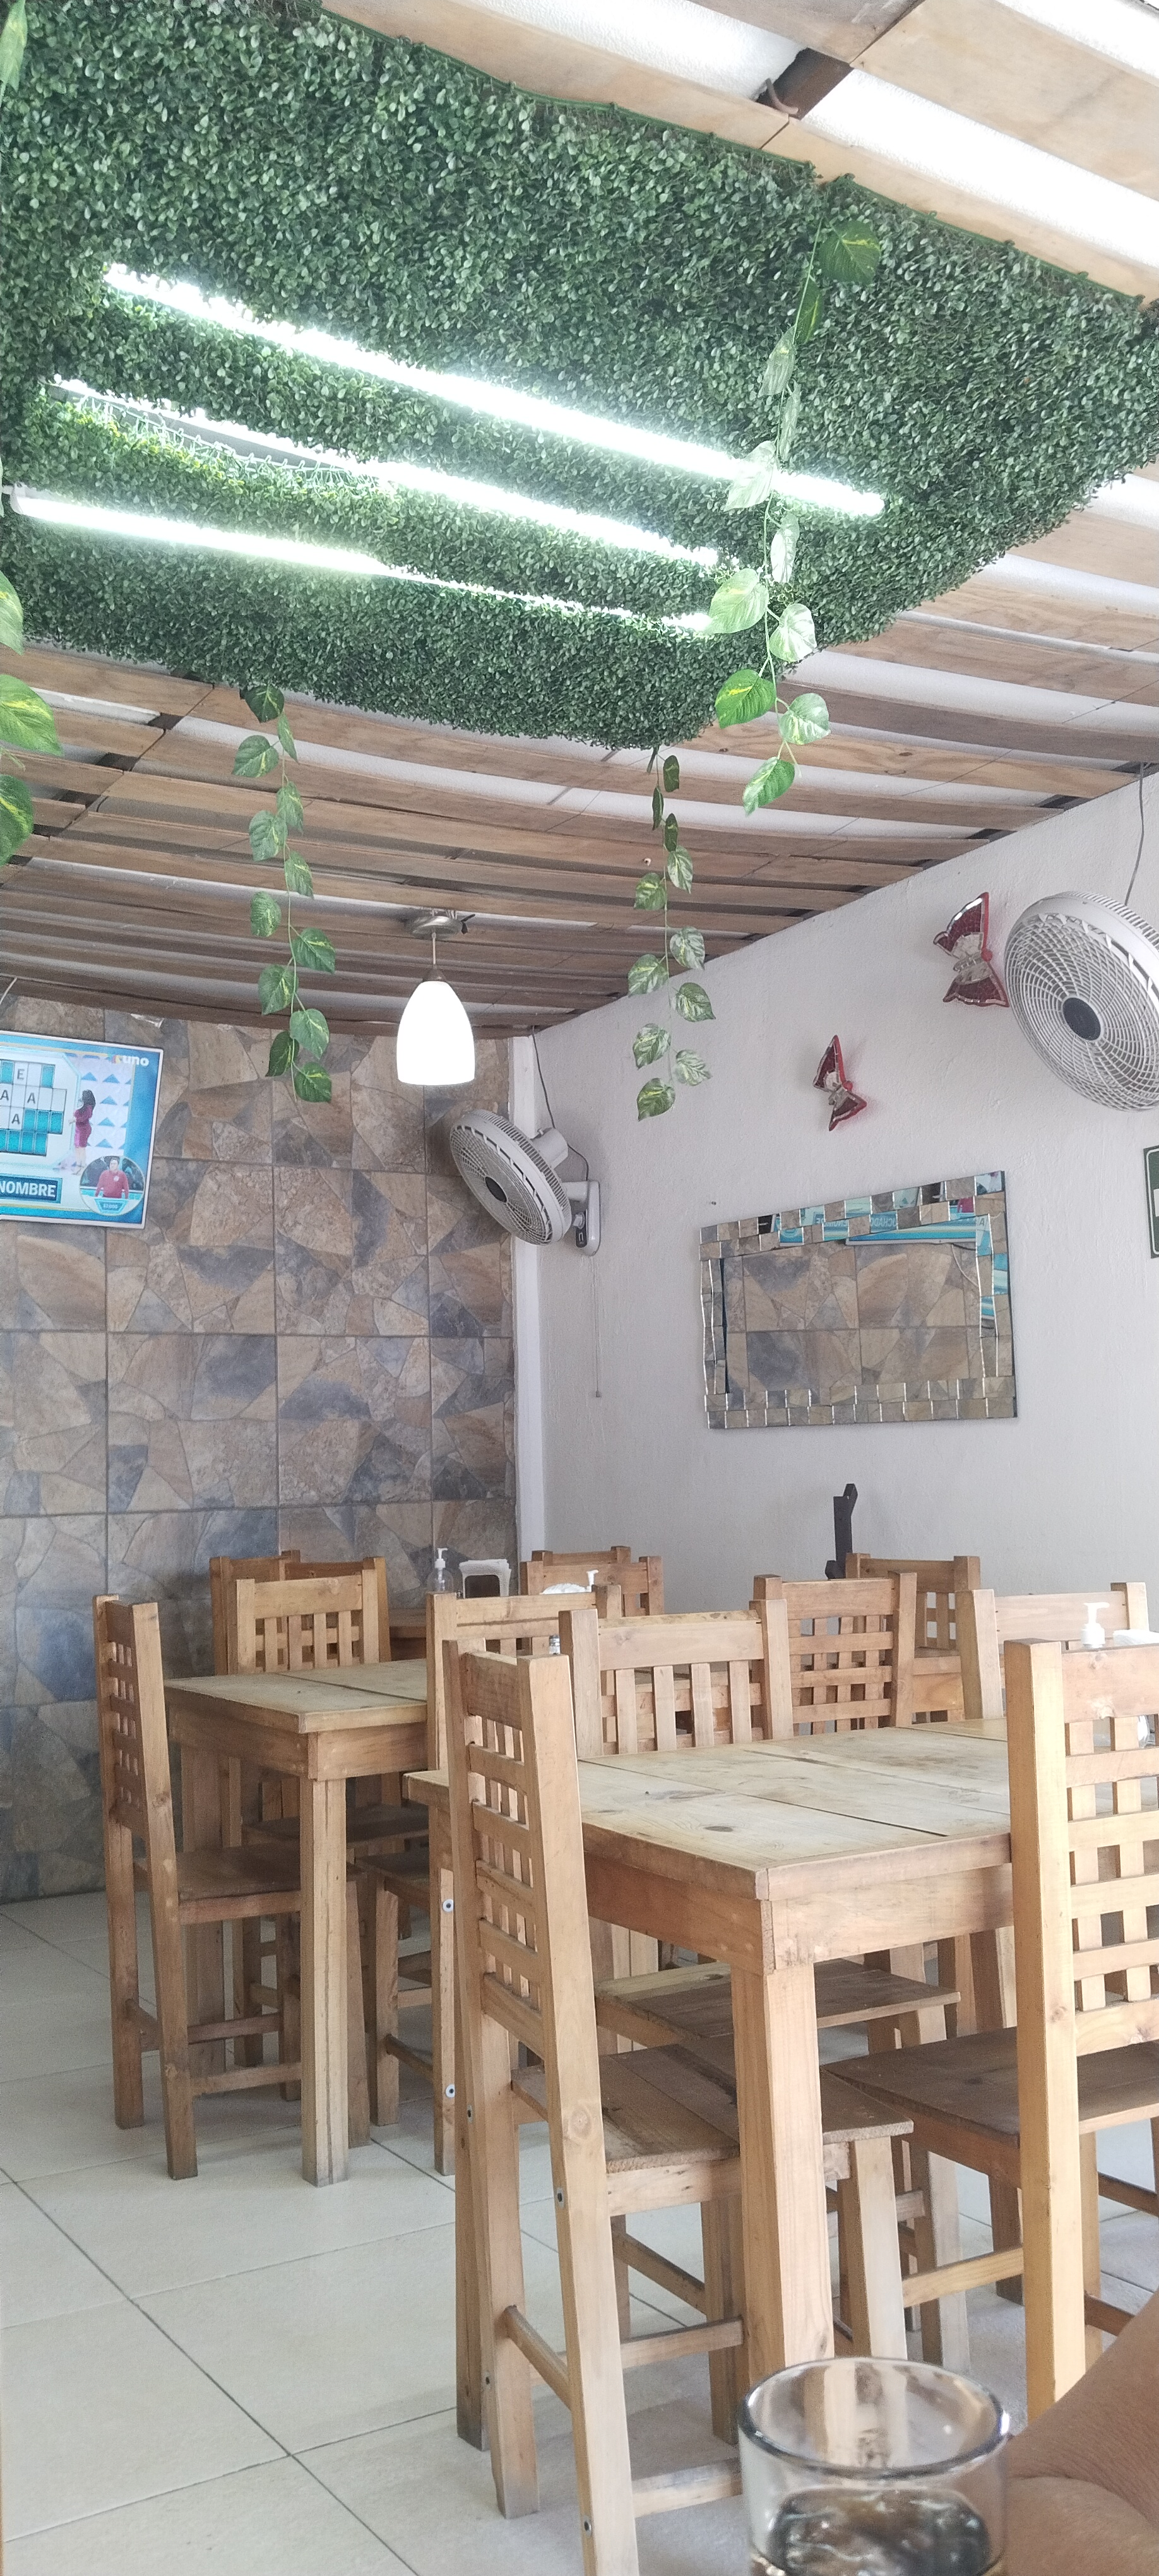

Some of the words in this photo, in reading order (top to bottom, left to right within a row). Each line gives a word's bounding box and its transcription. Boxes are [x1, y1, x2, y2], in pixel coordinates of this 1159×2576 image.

[122, 1055, 150, 1066] uno
[16, 1068, 25, 1080] E
[0, 1089, 9, 1101] A
[27, 1092, 36, 1104] A
[11, 1113, 20, 1125] A
